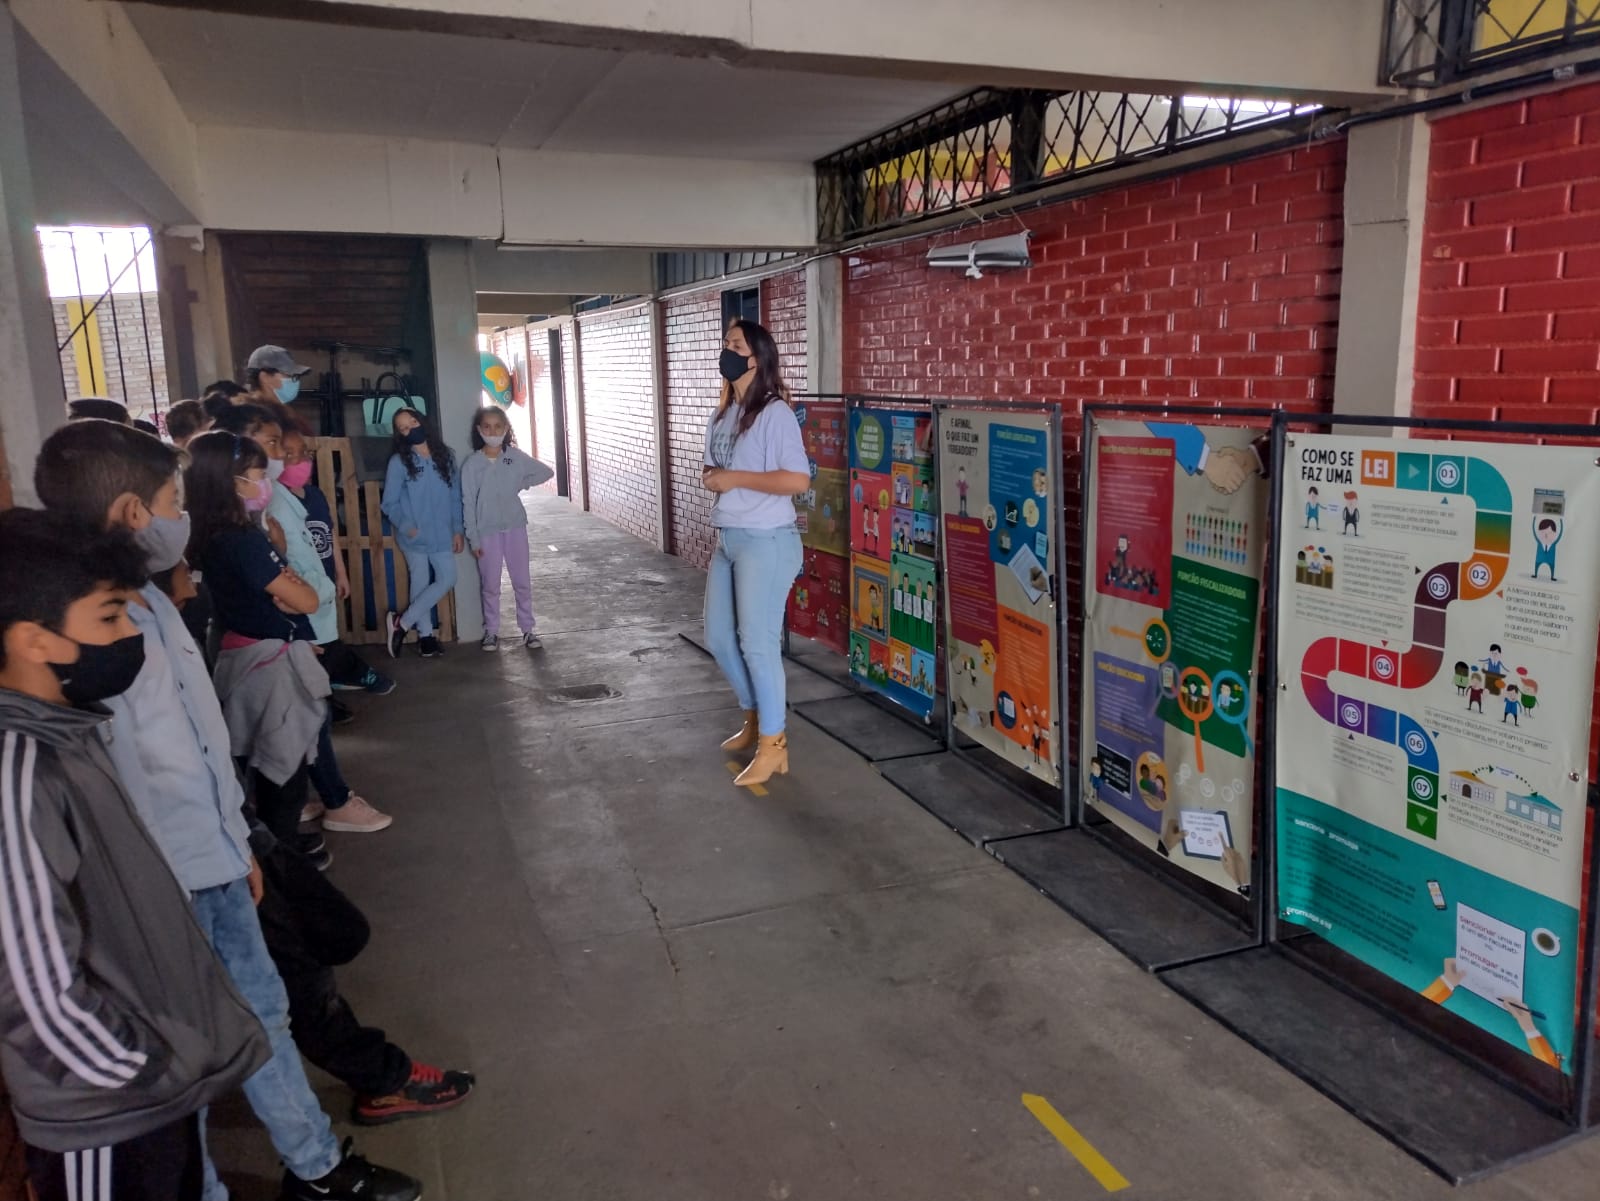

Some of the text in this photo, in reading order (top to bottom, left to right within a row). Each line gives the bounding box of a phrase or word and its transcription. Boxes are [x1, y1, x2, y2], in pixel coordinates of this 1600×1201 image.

[1302, 449, 1354, 467] COMO SE
[1364, 458, 1389, 479] LEI
[1441, 468, 1454, 479] 01
[1302, 466, 1352, 485] FAZ UMA
[1472, 569, 1487, 581] 02
[1432, 582, 1445, 593] 03
[1377, 661, 1389, 672] 04
[1345, 709, 1357, 720] 05
[1409, 738, 1422, 749] 06
[1416, 782, 1428, 793] 07
